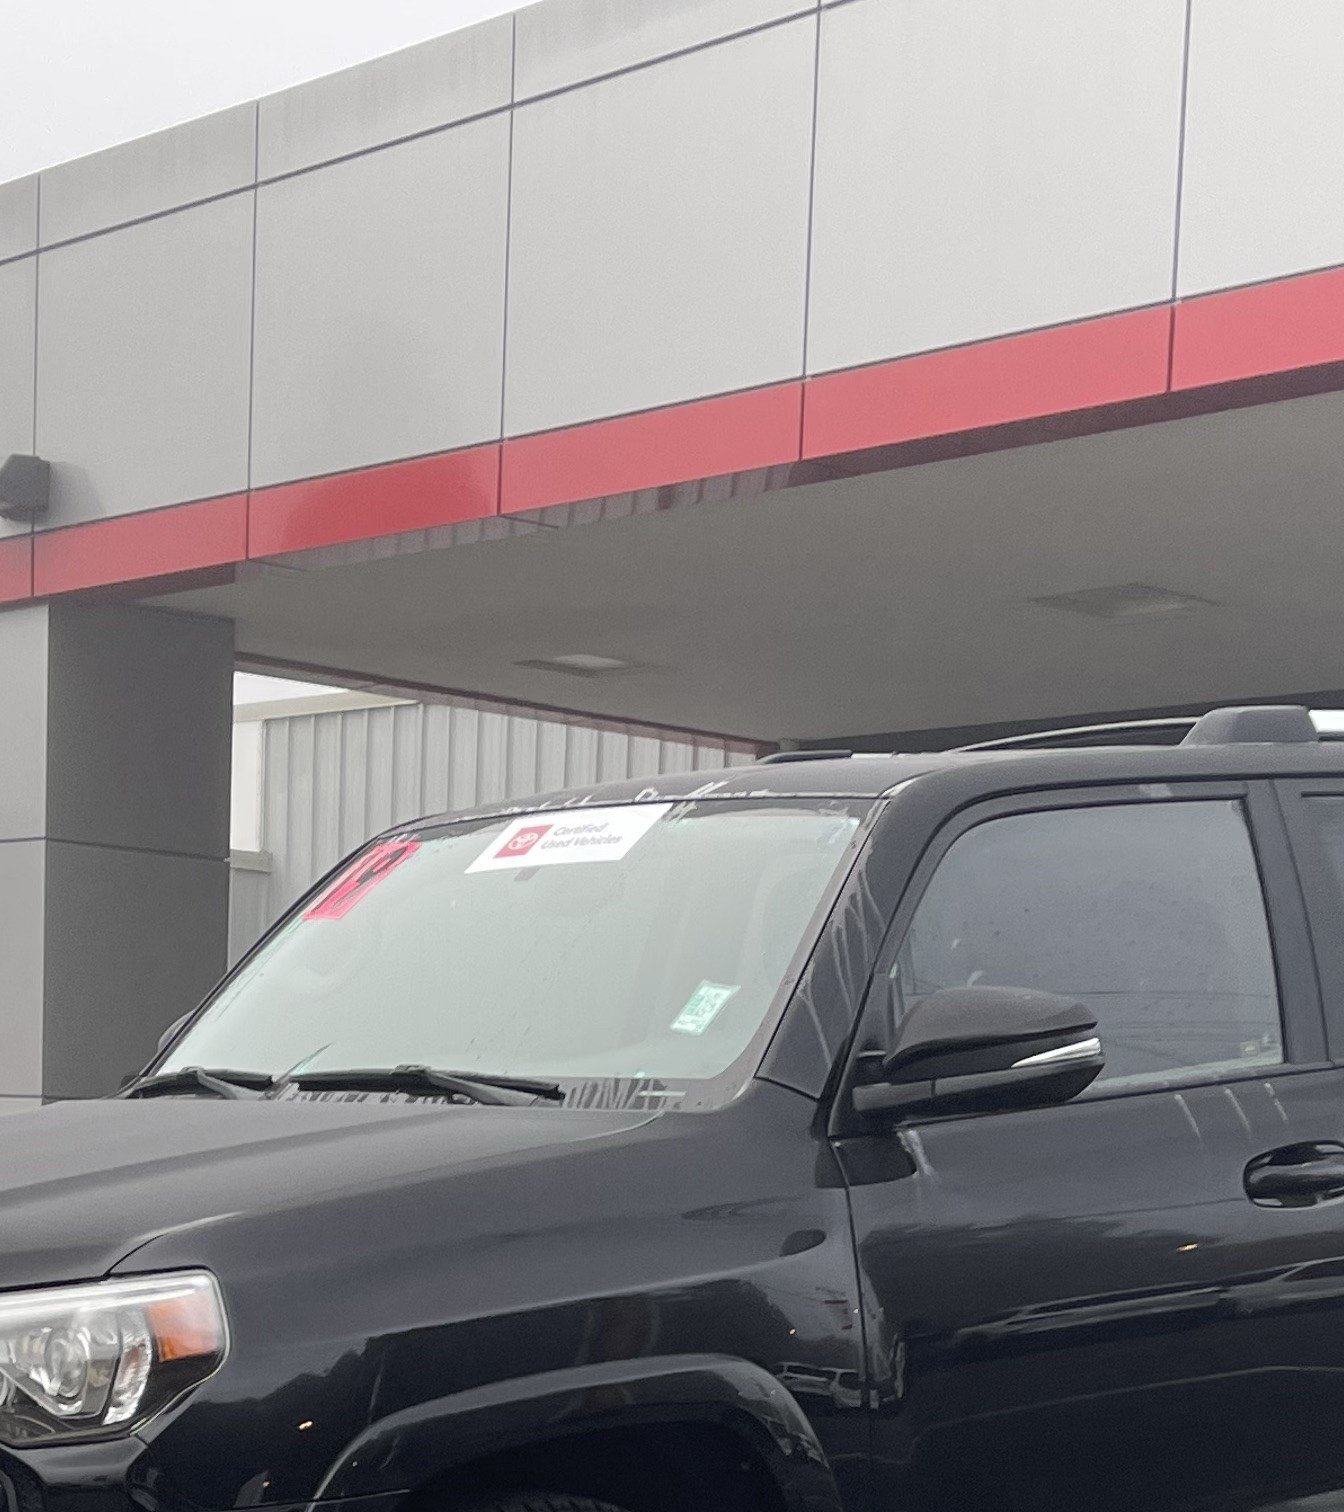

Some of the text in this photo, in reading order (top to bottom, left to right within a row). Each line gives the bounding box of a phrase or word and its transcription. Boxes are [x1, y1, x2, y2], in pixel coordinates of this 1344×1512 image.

[553, 822, 609, 836] Certified
[541, 834, 623, 850] Used Vehicles
